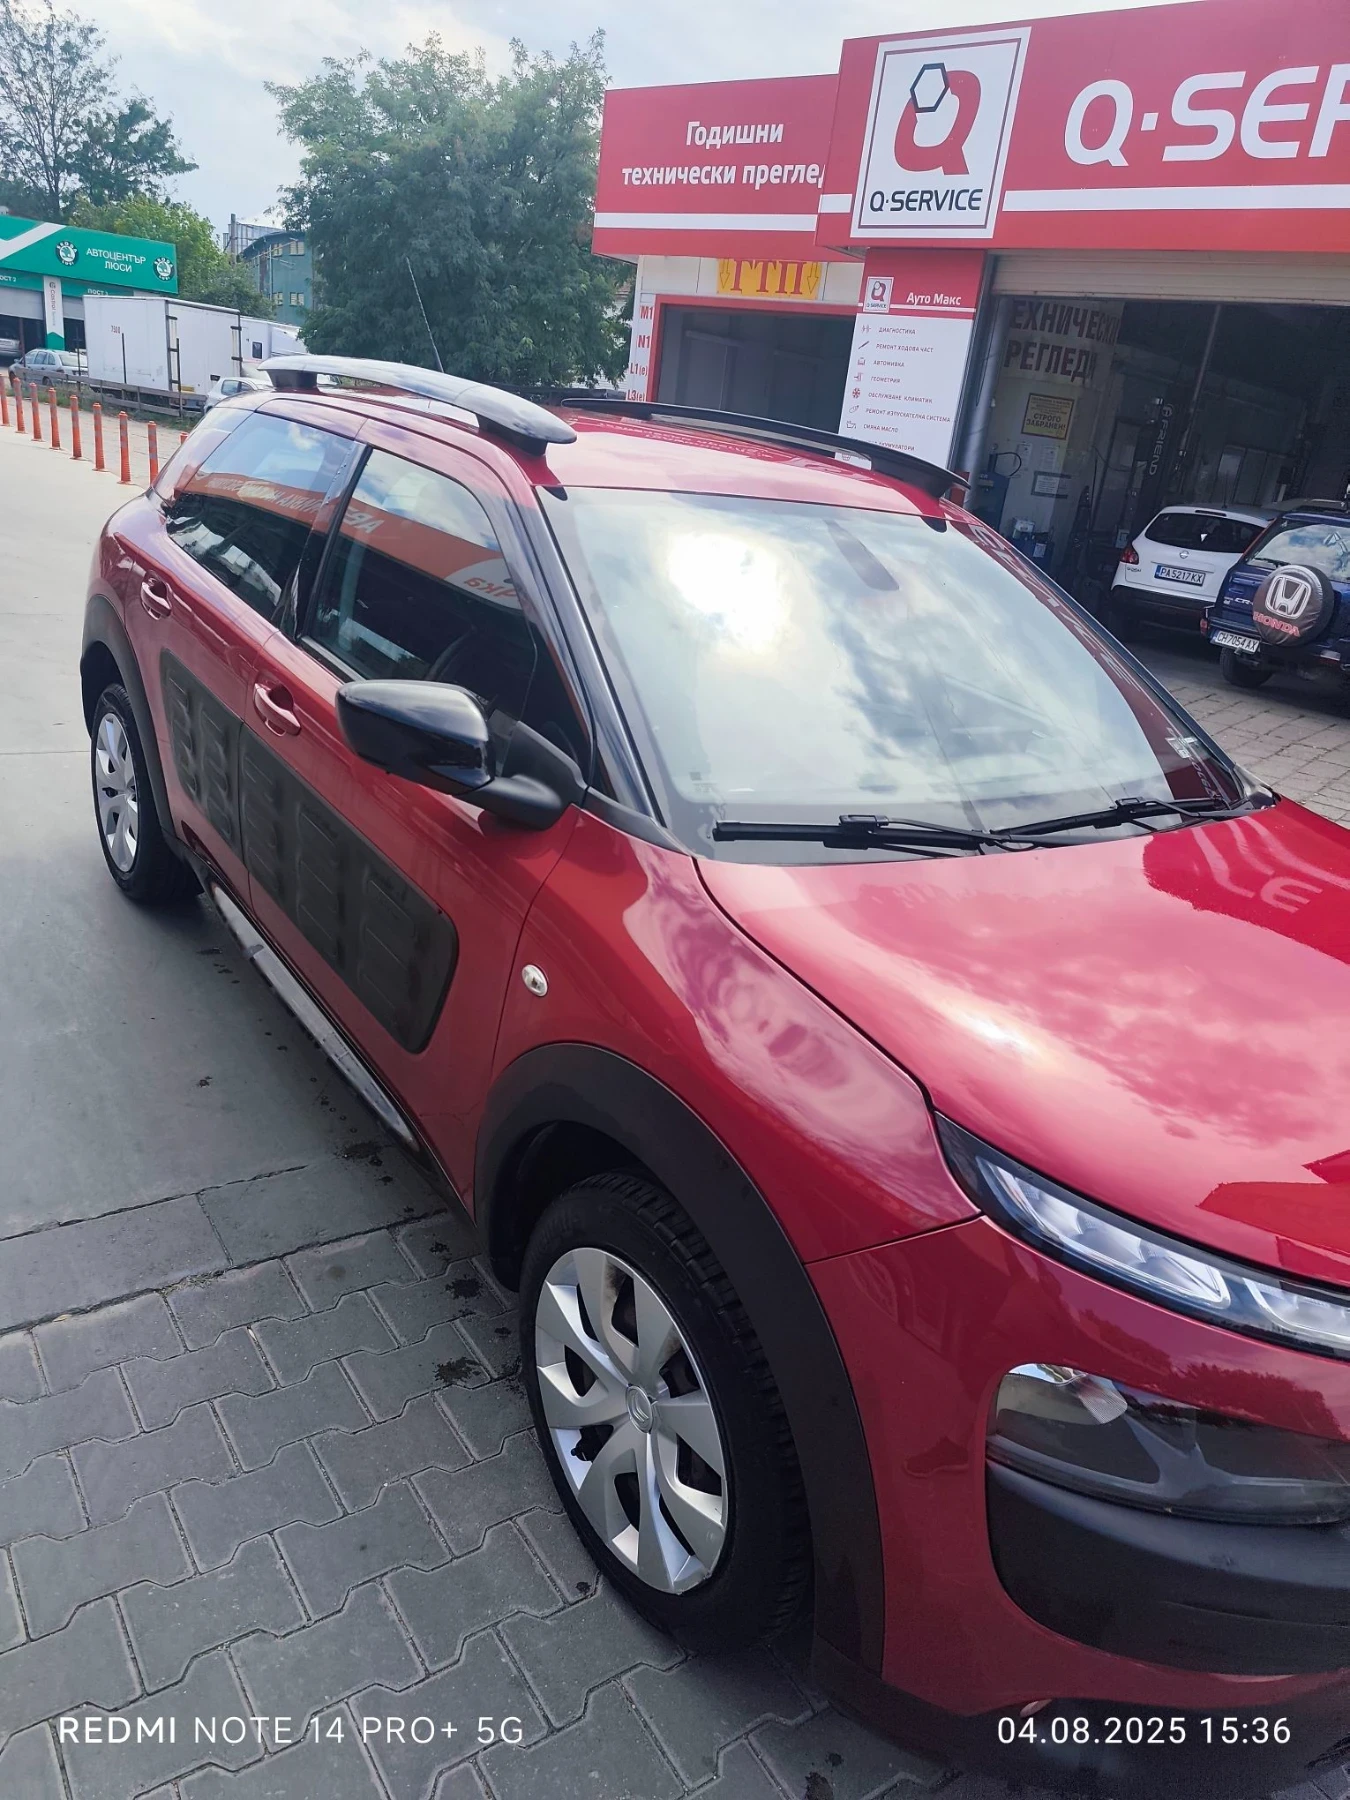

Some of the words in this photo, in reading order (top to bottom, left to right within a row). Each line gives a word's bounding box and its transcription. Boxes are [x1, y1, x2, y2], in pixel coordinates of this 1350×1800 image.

[686, 121, 784, 149] Годишни
[622, 165, 737, 186] технически
[86, 247, 147, 265] АВТОЦЕНТЪР
[104, 260, 133, 273] ЛЮСИ
[906, 292, 931, 306] Ауто
[933, 293, 962, 306] Макс
[878, 327, 916, 335] ДИАГНОСТИКА
[1033, 412, 1061, 423] СТРОГО
[1253, 611, 1300, 638] HONDA
